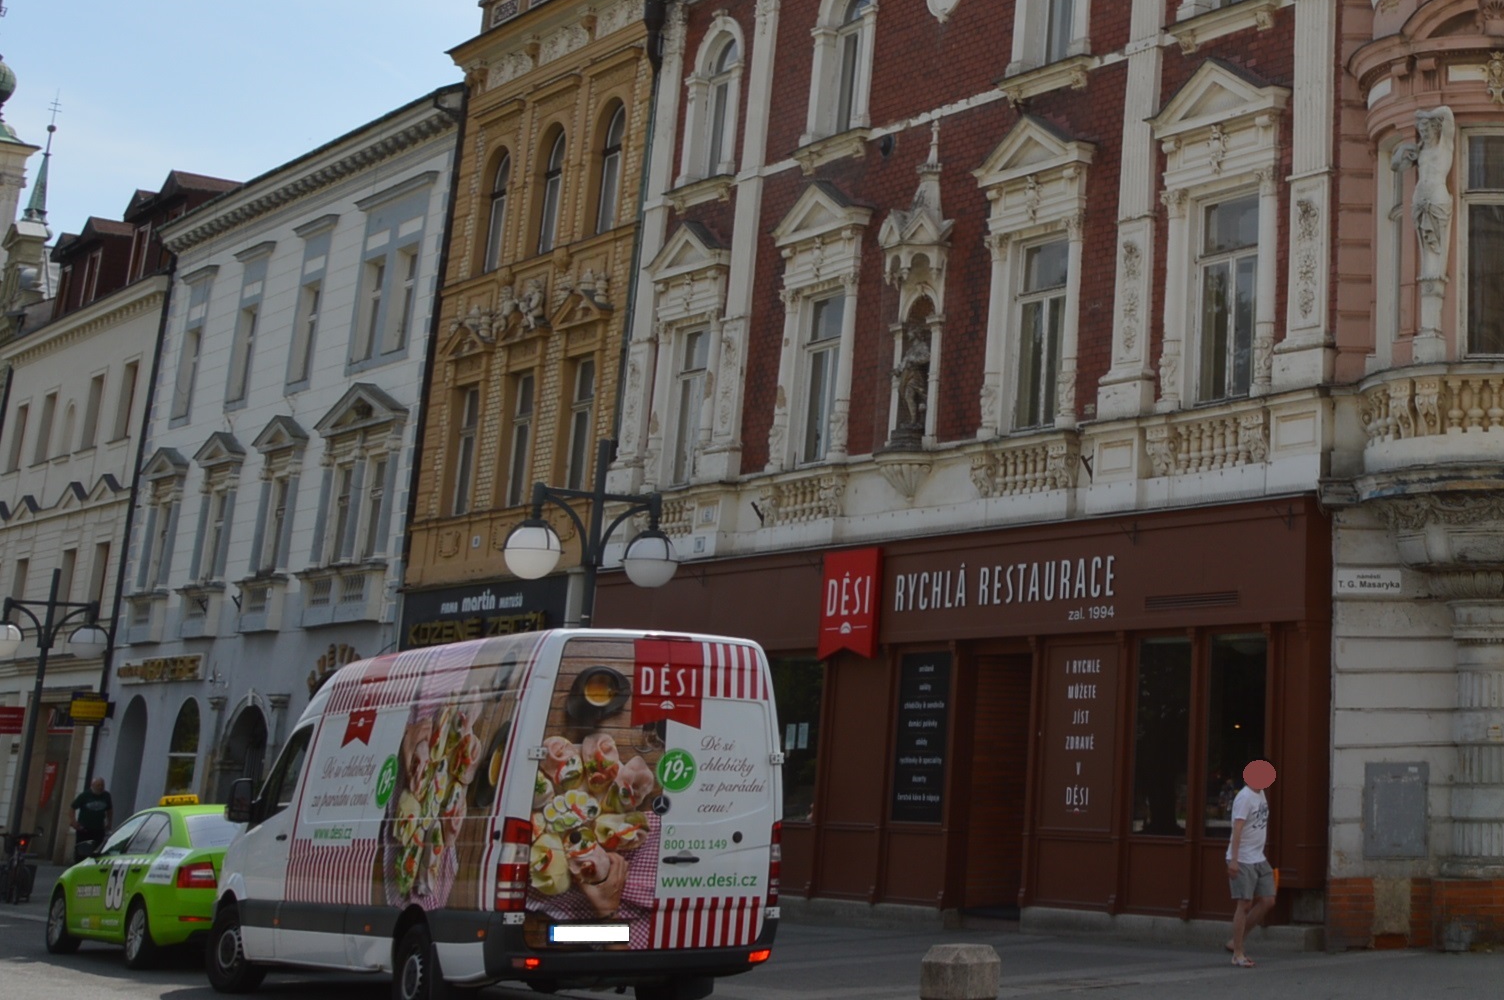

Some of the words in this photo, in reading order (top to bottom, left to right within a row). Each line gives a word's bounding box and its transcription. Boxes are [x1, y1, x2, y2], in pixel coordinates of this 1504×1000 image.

[894, 563, 967, 612] RYCHLÁ
[978, 555, 1116, 606] RESTAURACE
[1338, 580, 1345, 588] T.
[1347, 580, 1357, 588] G.
[1360, 580, 1400, 590] Masaryka
[462, 588, 496, 613] martin
[1068, 607, 1086, 621] zal.
[1088, 605, 1115, 619] 1994
[1072, 659, 1101, 674] RYCHLE
[641, 663, 697, 697] DÉSI
[1072, 708, 1090, 725] JÍST
[699, 757, 755, 777] chlebíčky
[714, 779, 766, 797] parádní
[697, 801, 733, 814] cenu!
[664, 839, 686, 850] 800
[688, 839, 706, 850] 101
[708, 838, 728, 850] 149
[661, 873, 758, 888] www.desi.cz
